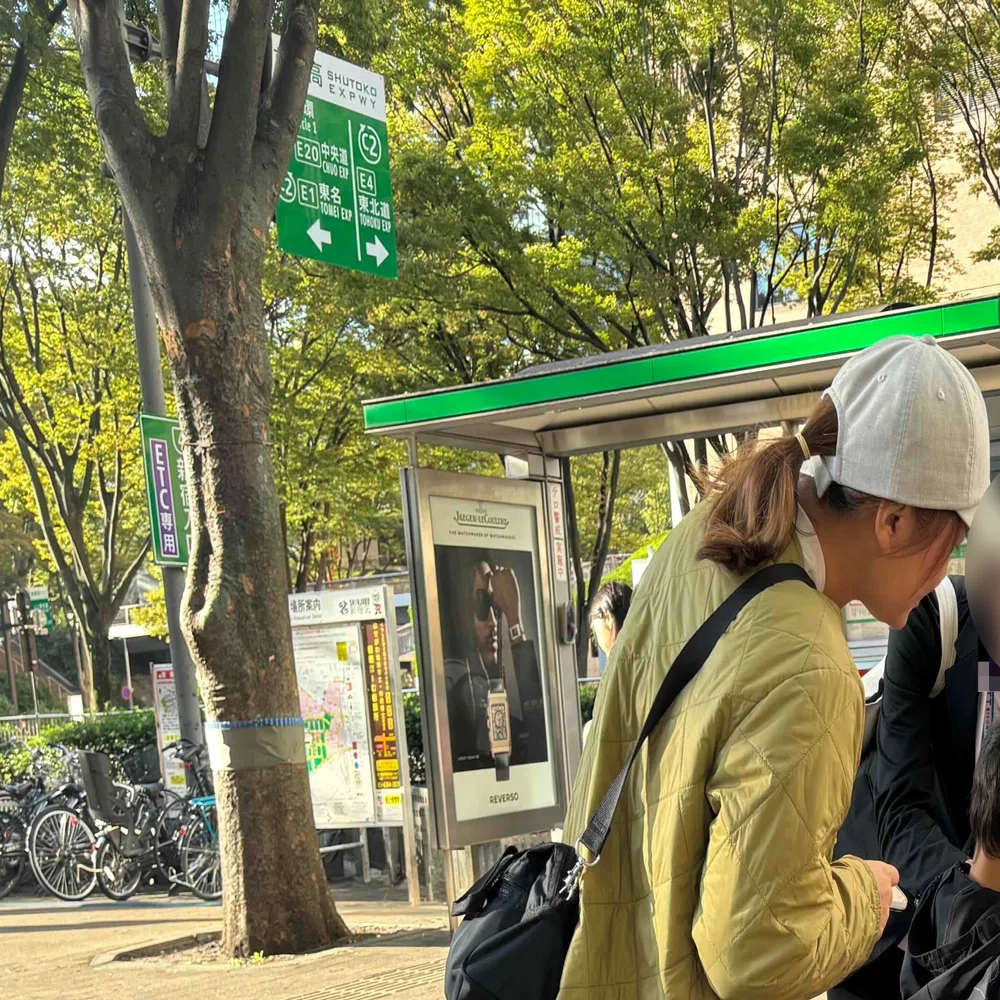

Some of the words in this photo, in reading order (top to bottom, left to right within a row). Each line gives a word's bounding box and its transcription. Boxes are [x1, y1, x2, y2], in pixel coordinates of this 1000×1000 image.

[327, 70, 377, 97] SHUTOKO
[329, 84, 376, 109] EXPWY
[296, 140, 319, 162] E20
[321, 142, 348, 166] 中央道
[361, 133, 378, 158] C2
[322, 161, 338, 177] CHUO
[338, 165, 349, 180] EXP
[359, 172, 374, 191] E4
[301, 185, 315, 203] E1
[319, 183, 341, 206] 東名
[320, 202, 340, 219] TOMEI
[341, 206, 352, 222] EXP
[358, 195, 391, 220] 東北道
[359, 213, 381, 231] TOHOKU
[381, 218, 392, 233] EXP
[154, 443, 176, 554] ETC専用
[489, 791, 519, 804] REVERSO
